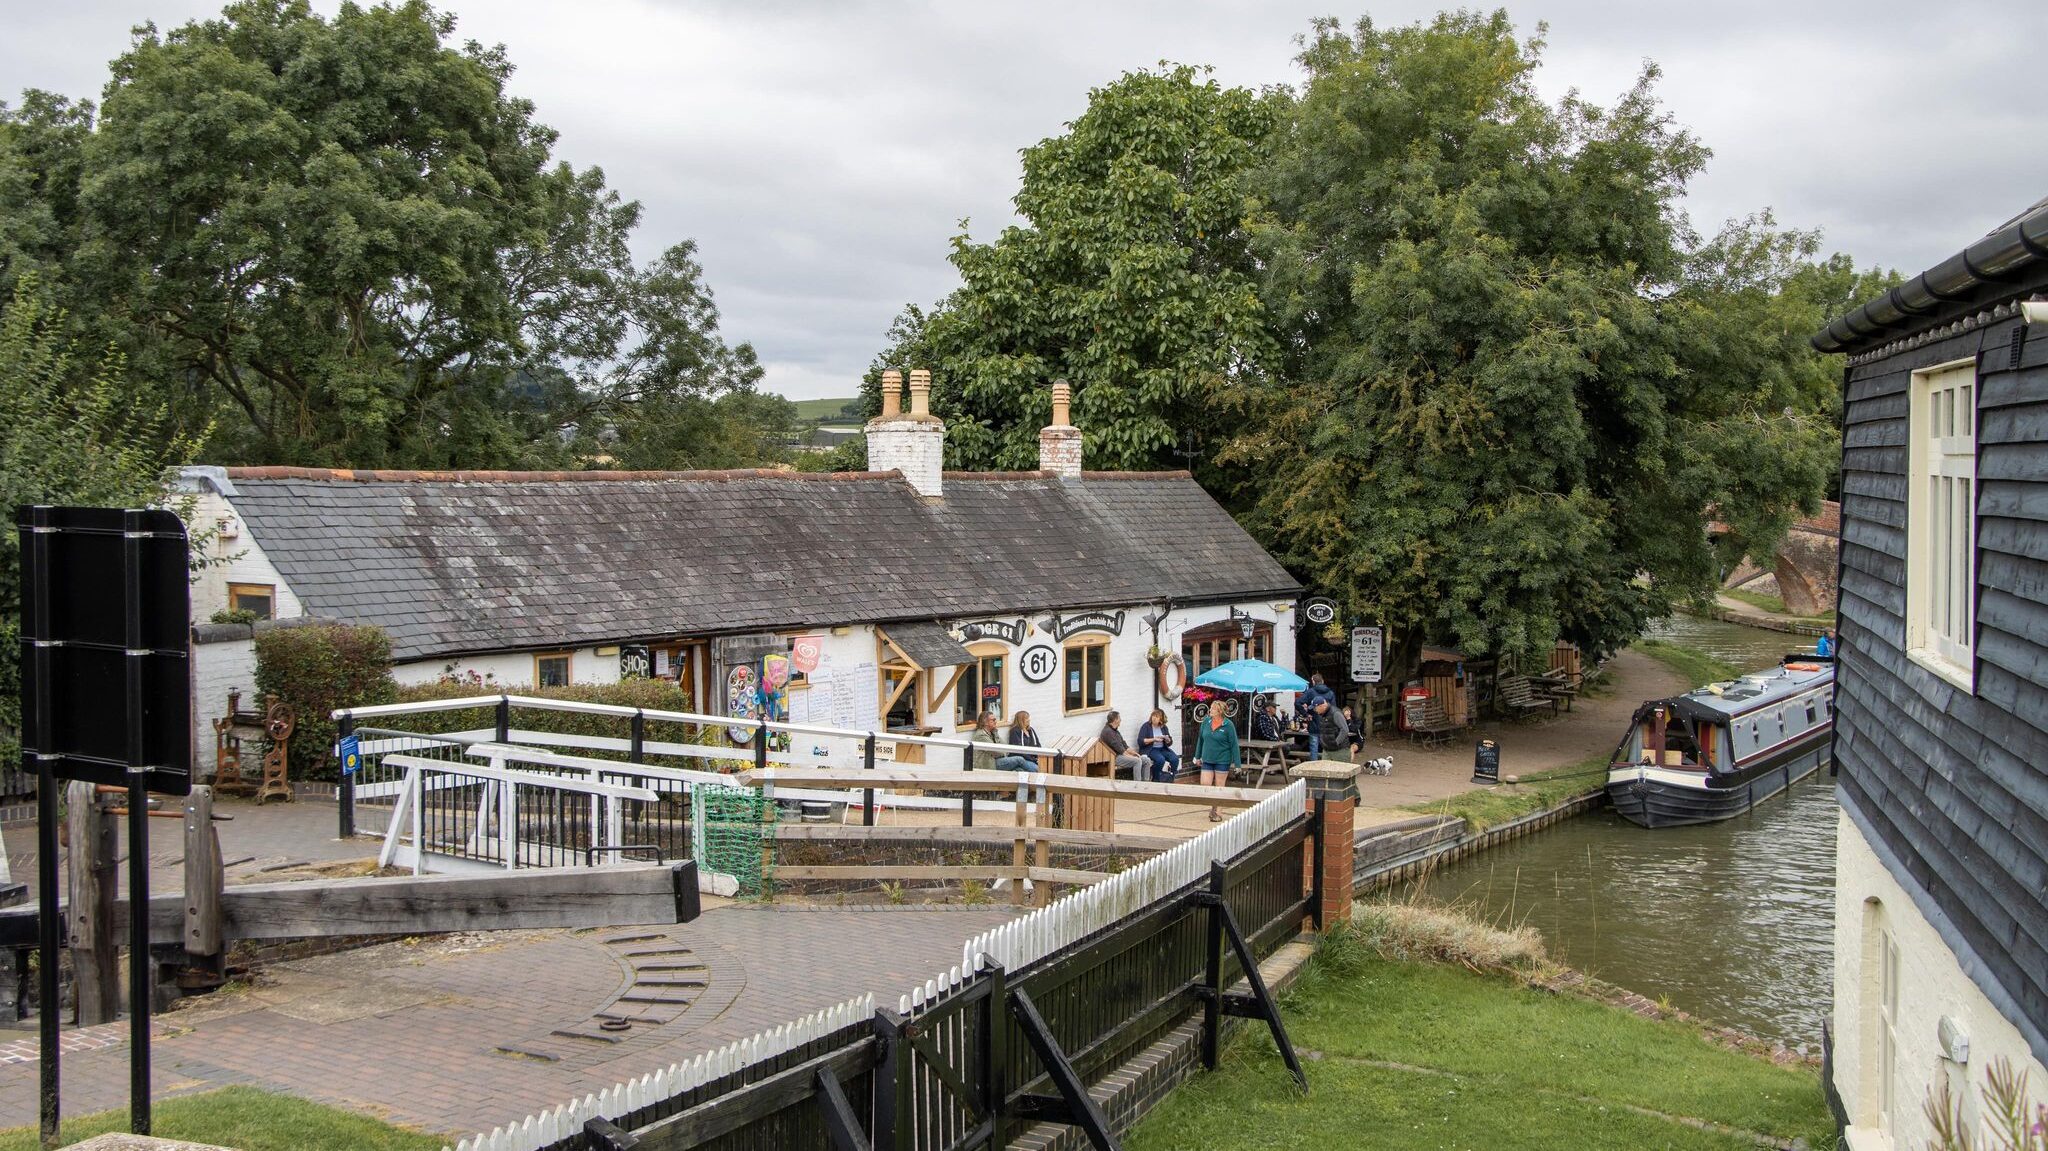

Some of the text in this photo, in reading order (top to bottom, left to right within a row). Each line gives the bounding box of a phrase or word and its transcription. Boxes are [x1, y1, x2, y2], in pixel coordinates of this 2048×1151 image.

[958, 623, 1014, 643] BDGE 61
[1063, 617, 1087, 634] Traditional
[1361, 637, 1372, 645] 61
[620, 655, 649, 676] SHOP
[1030, 652, 1047, 674] 61
[983, 686, 999, 698] OPEN
